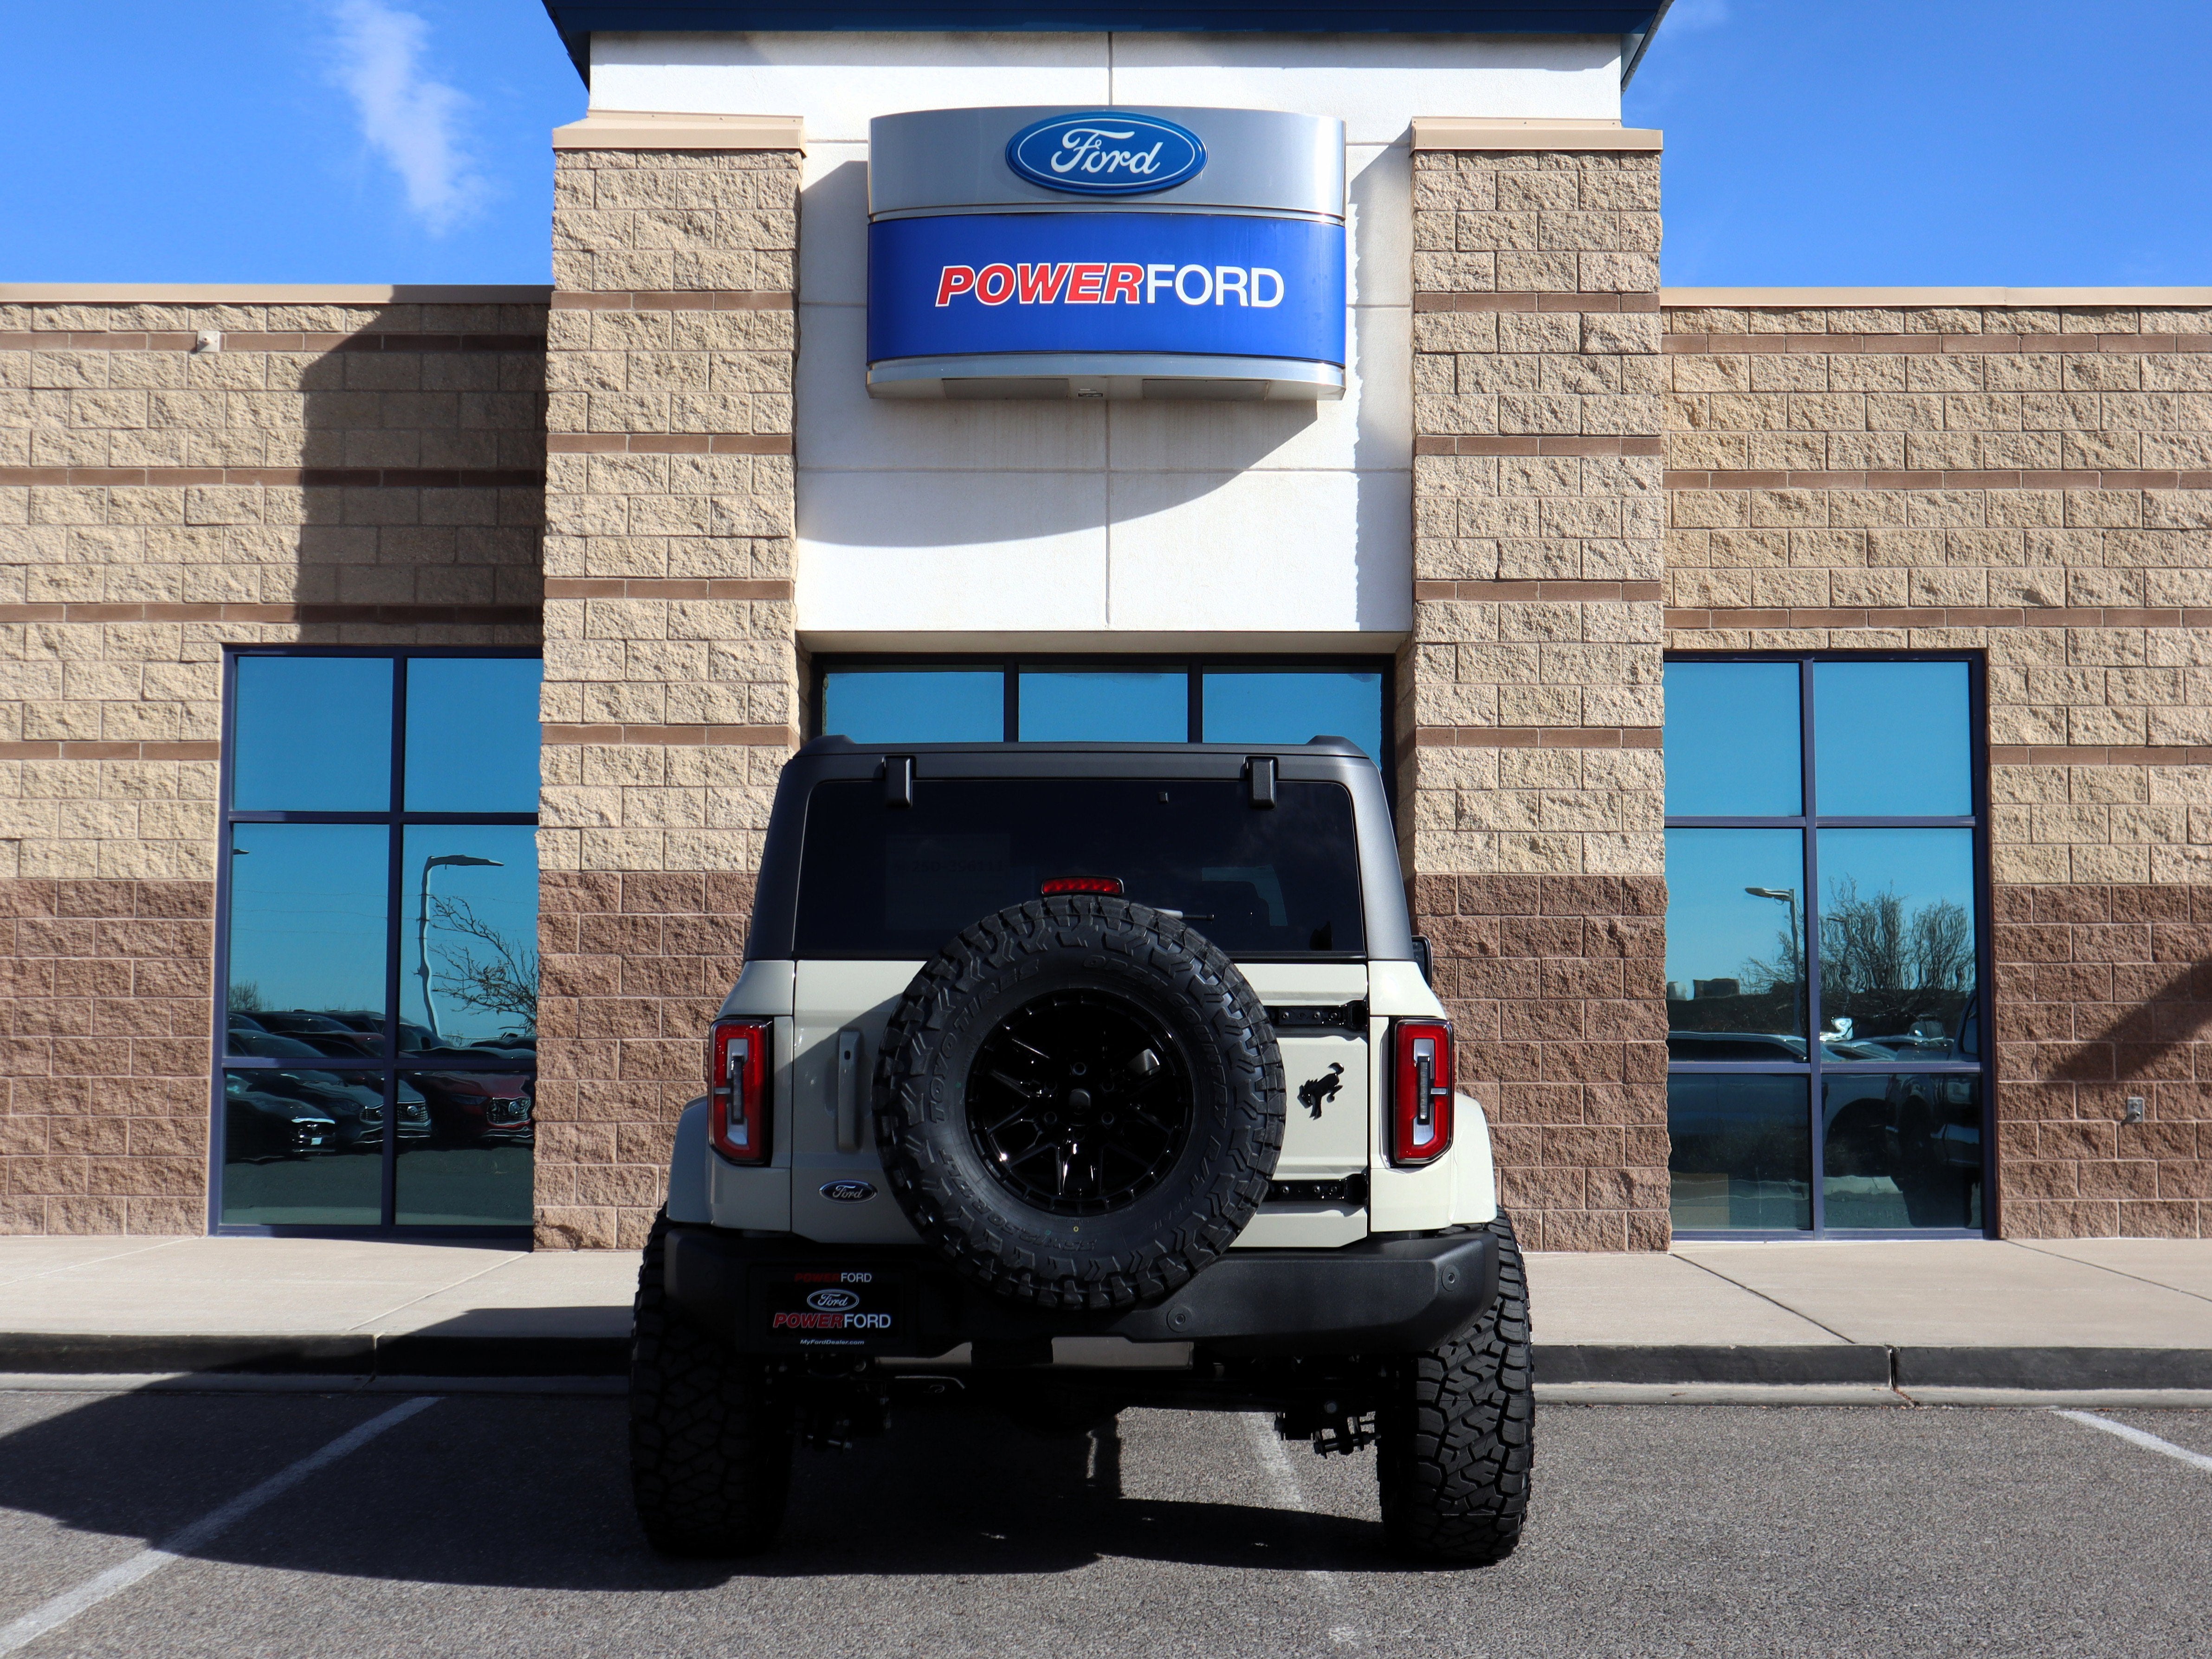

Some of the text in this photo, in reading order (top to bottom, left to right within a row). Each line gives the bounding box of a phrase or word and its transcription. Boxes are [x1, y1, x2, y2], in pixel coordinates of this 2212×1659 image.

[1051, 128, 1163, 174] Ford
[930, 1032, 957, 1123] TOYO
[954, 958, 1039, 1033] TIRES
[1082, 955, 1169, 993] OPEN
[1167, 992, 1228, 1129] COUNTRY
[832, 1185, 863, 1198] Ford
[817, 1293, 847, 1306] Ford
